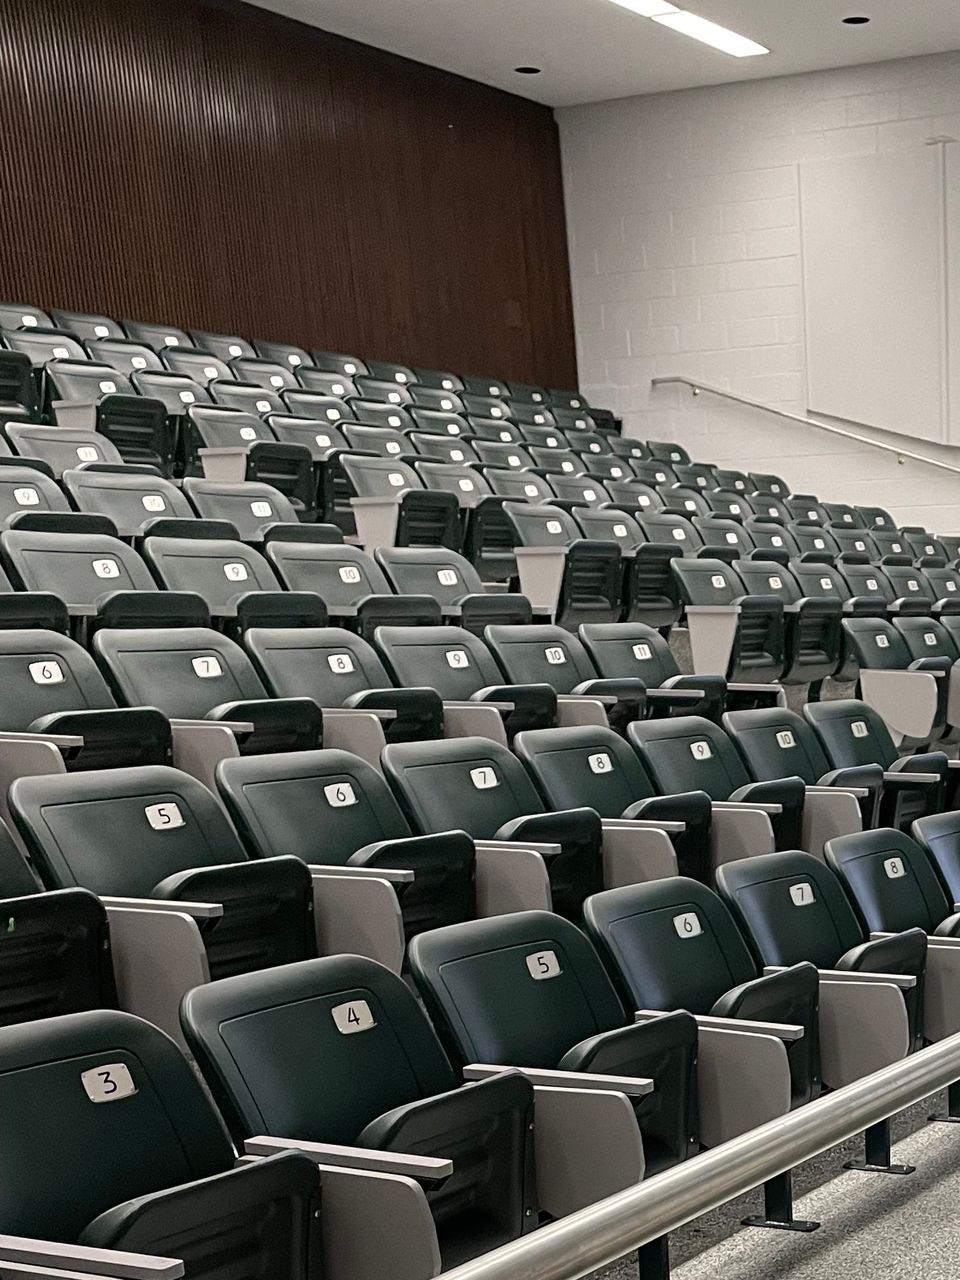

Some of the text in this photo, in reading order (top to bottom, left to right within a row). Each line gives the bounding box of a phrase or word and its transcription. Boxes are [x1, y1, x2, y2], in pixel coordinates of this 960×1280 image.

[84, 449, 93, 459] 11
[22, 491, 31, 502] 9
[257, 504, 266, 513] 11
[101, 562, 111, 575] 8
[231, 566, 240, 577] 9
[344, 569, 357, 580] 10
[443, 572, 453, 582] 11
[549, 649, 562, 661] 10
[637, 646, 647, 657] 11
[336, 657, 346, 670] 8
[453, 653, 461, 665] 9
[42, 665, 53, 680] 6
[201, 660, 210, 673] 7
[854, 724, 865, 735] 11
[780, 733, 792, 745] 10
[696, 744, 704, 756] 9
[596, 756, 605, 770] 8
[478, 770, 487, 785] 7
[336, 787, 346, 802] 6
[157, 808, 171, 825] 5
[890, 861, 899, 874] 8
[796, 887, 804, 901] 7
[683, 917, 693, 933] 6
[537, 956, 550, 974] 5
[346, 1007, 361, 1026] 4
[97, 1071, 118, 1095] 3
